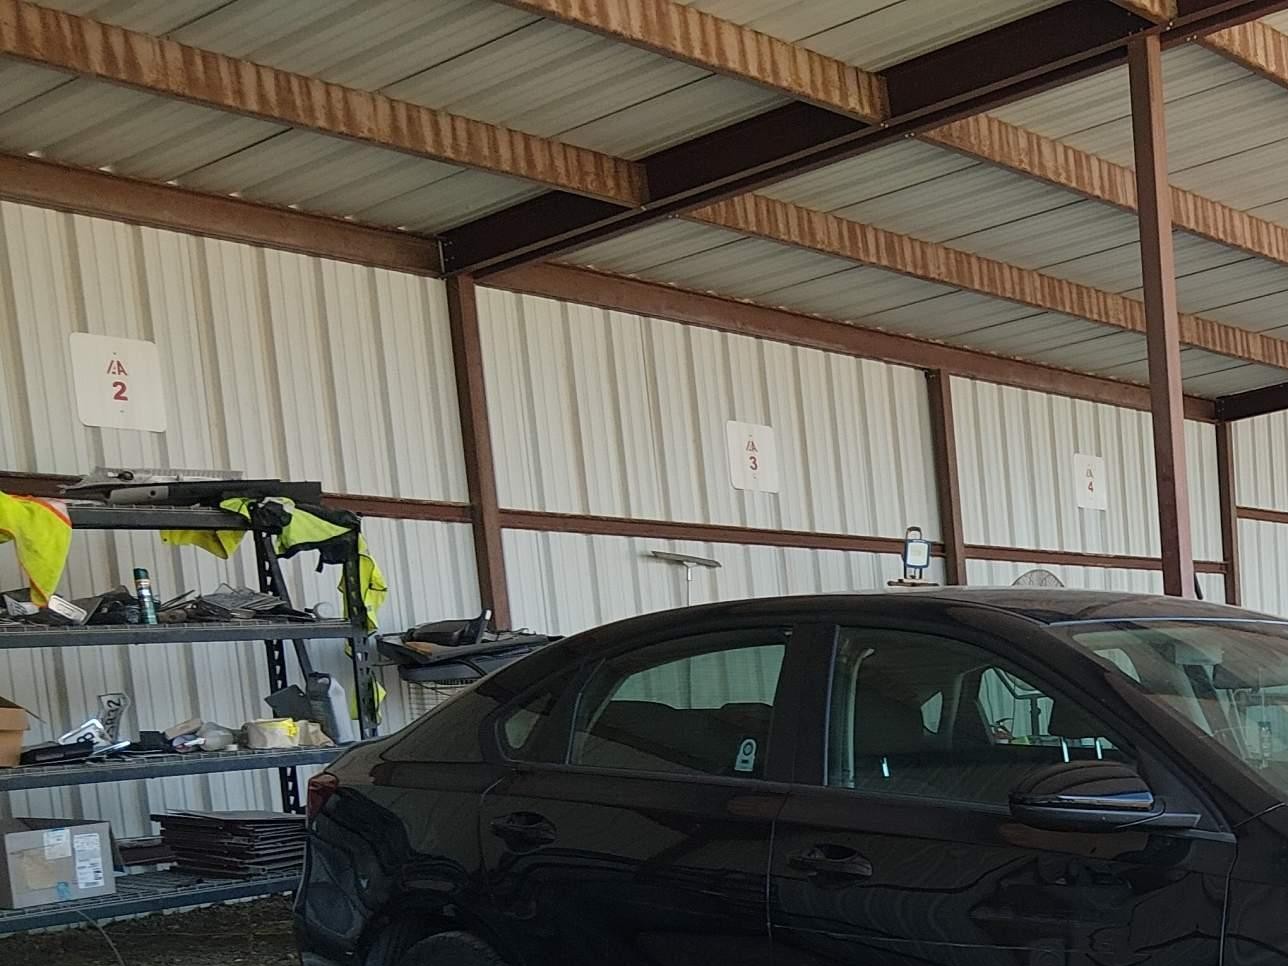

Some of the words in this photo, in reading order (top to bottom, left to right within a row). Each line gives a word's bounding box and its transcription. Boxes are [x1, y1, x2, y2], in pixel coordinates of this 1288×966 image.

[112, 381, 128, 401] 2
[749, 456, 758, 470] 3
[1088, 481, 1094, 492] 4
